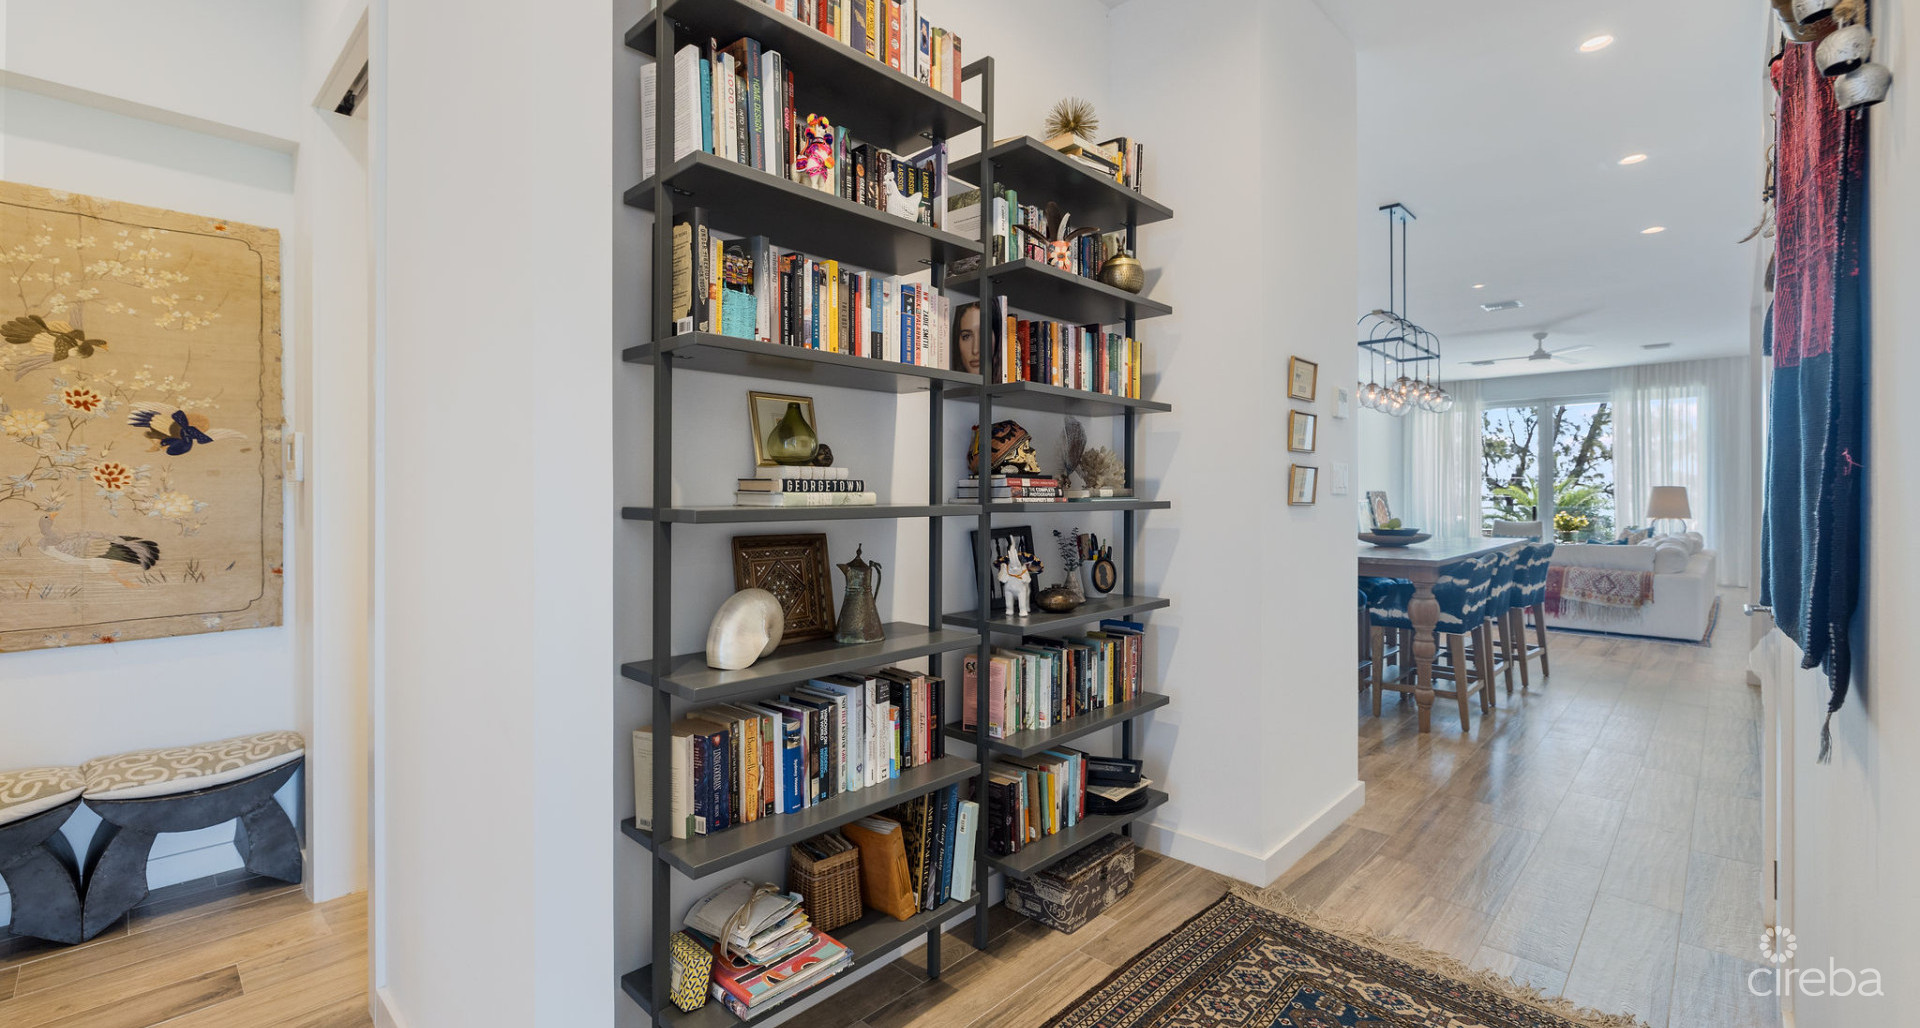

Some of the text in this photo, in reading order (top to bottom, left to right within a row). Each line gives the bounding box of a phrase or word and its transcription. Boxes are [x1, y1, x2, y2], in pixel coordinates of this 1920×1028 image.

[753, 78, 762, 102] HOME
[754, 103, 762, 134] DESIGN
[786, 480, 862, 492] GEORGETOWN
[713, 748, 721, 765] LINDA
[747, 736, 755, 772] Botticelli
[926, 805, 934, 848] AMERICAN
[934, 848, 945, 870] Beauty
[1049, 904, 1066, 919] 1859
